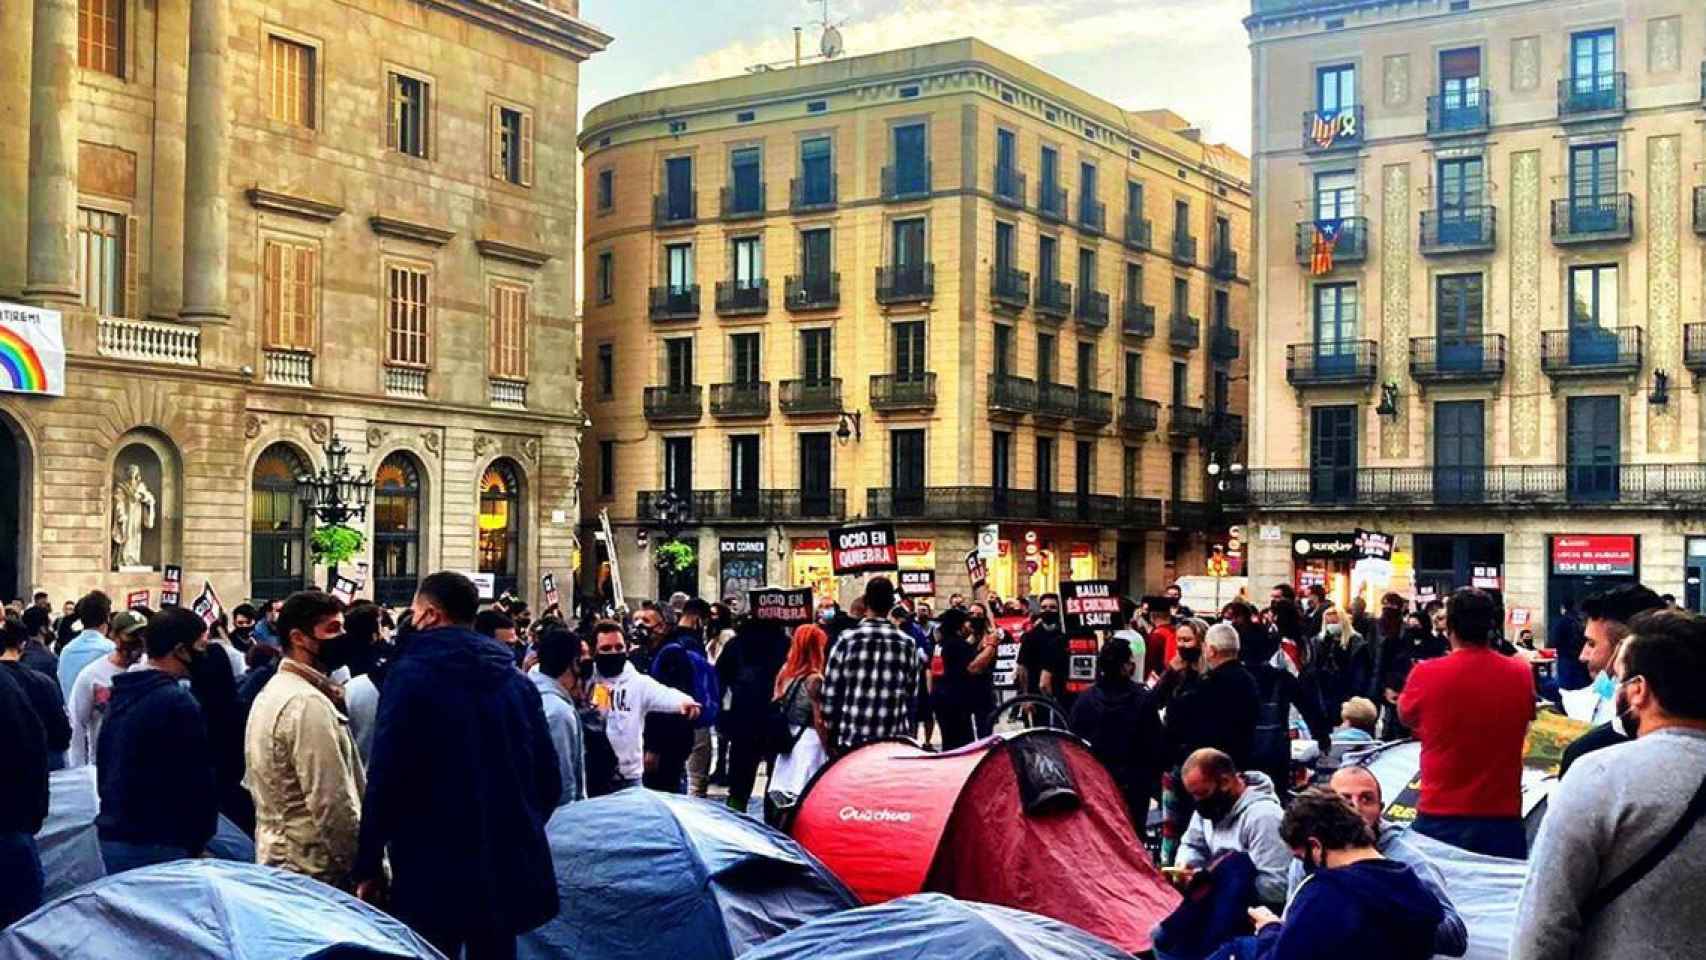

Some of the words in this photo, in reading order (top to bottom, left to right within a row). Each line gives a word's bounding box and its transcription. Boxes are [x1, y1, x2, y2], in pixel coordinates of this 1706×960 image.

[839, 531, 868, 548] OCIO
[871, 530, 887, 546] EN
[838, 546, 892, 568] QUIEBRA
[759, 594, 786, 606] OCIO
[789, 593, 804, 607] EN
[758, 606, 807, 620] QUIEBRA
[1085, 612, 1112, 626] SALUT
